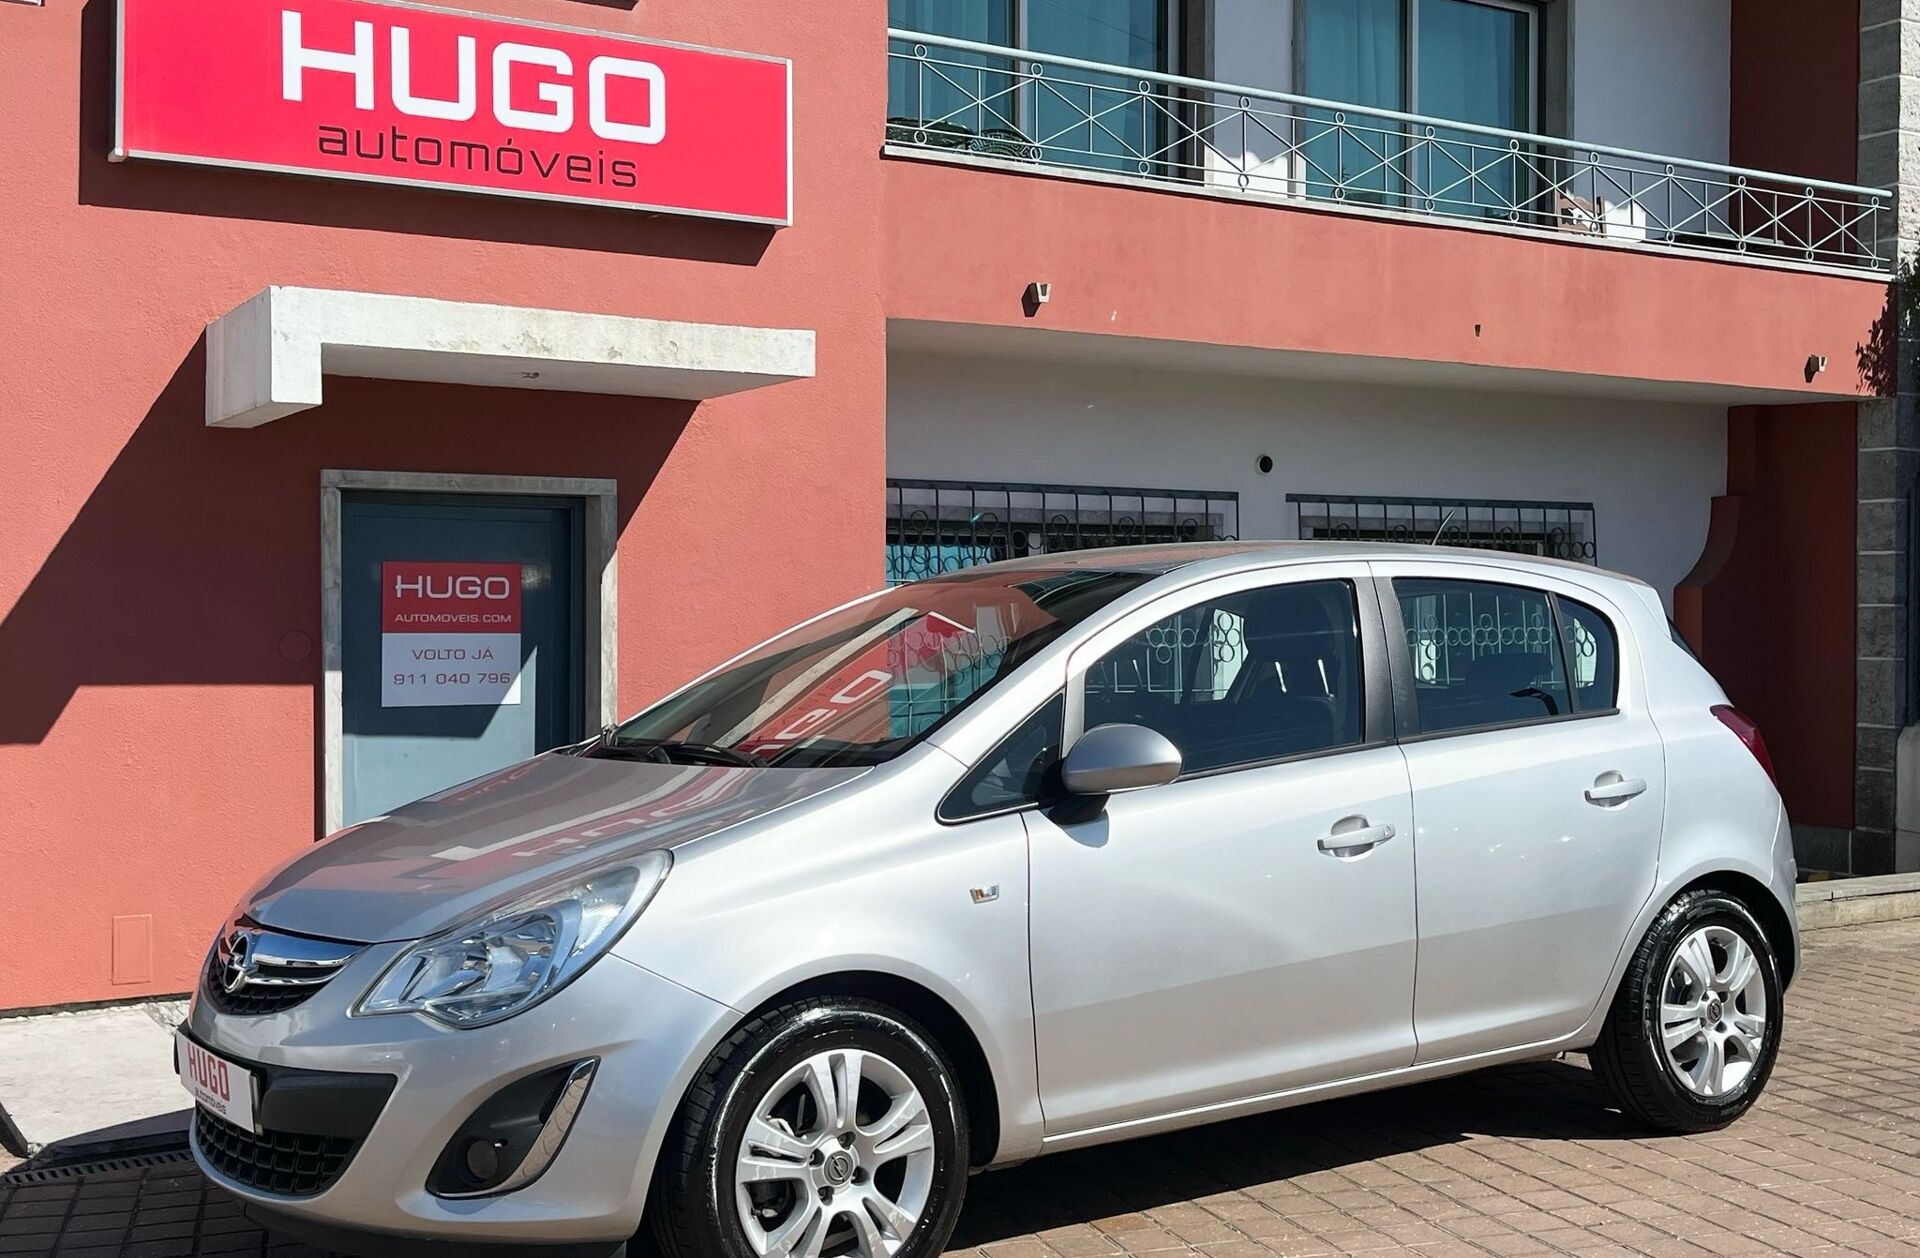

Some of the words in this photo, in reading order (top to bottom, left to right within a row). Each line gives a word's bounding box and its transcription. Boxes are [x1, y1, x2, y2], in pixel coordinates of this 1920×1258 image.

[281, 9, 666, 145] HUGO
[318, 125, 637, 188] automóveis
[395, 575, 510, 599] HUGO
[411, 648, 466, 660] VOLTO
[471, 646, 494, 660] JÁ
[393, 673, 427, 685] 911
[435, 673, 470, 684] 040
[477, 672, 511, 684] 796
[187, 1041, 230, 1102] HUGO
